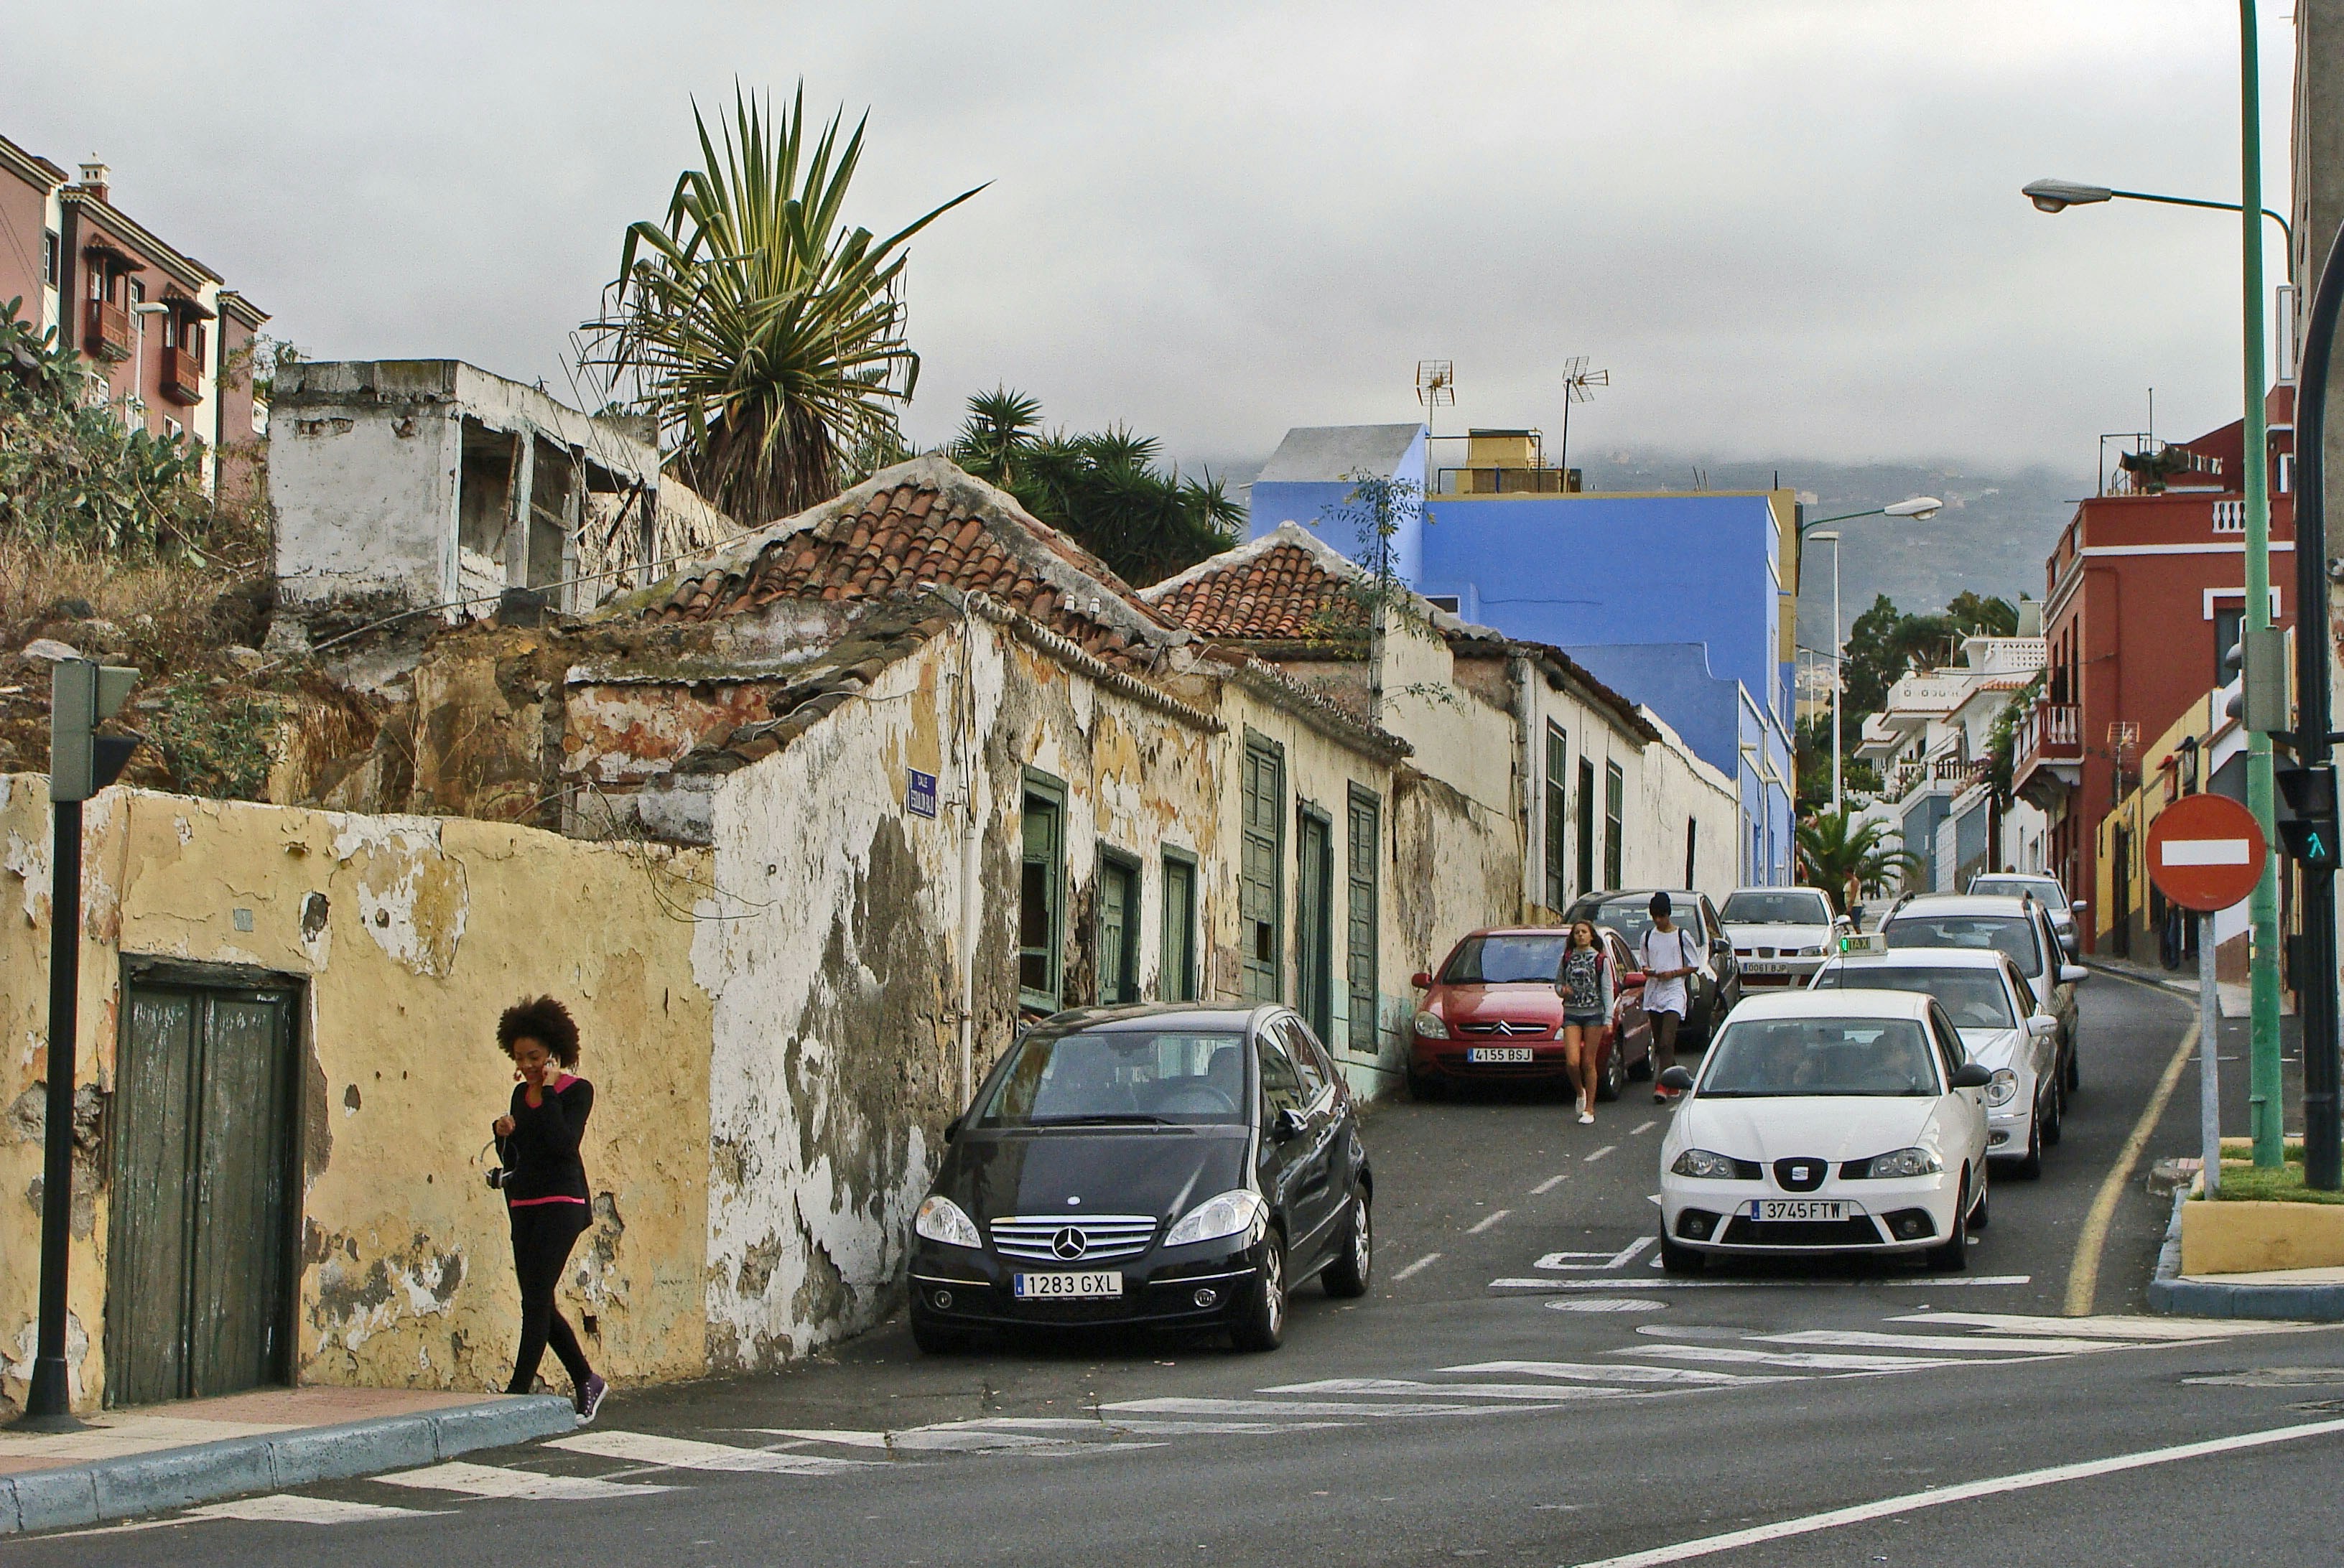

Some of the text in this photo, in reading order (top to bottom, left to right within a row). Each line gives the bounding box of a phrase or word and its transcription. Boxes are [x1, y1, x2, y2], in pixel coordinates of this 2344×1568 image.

[1849, 938, 1870, 949] TAXI
[1476, 1050, 1530, 1060] 4155 BSJ
[1029, 1276, 1074, 1294] 1283
[1081, 1275, 1117, 1292] GXL
